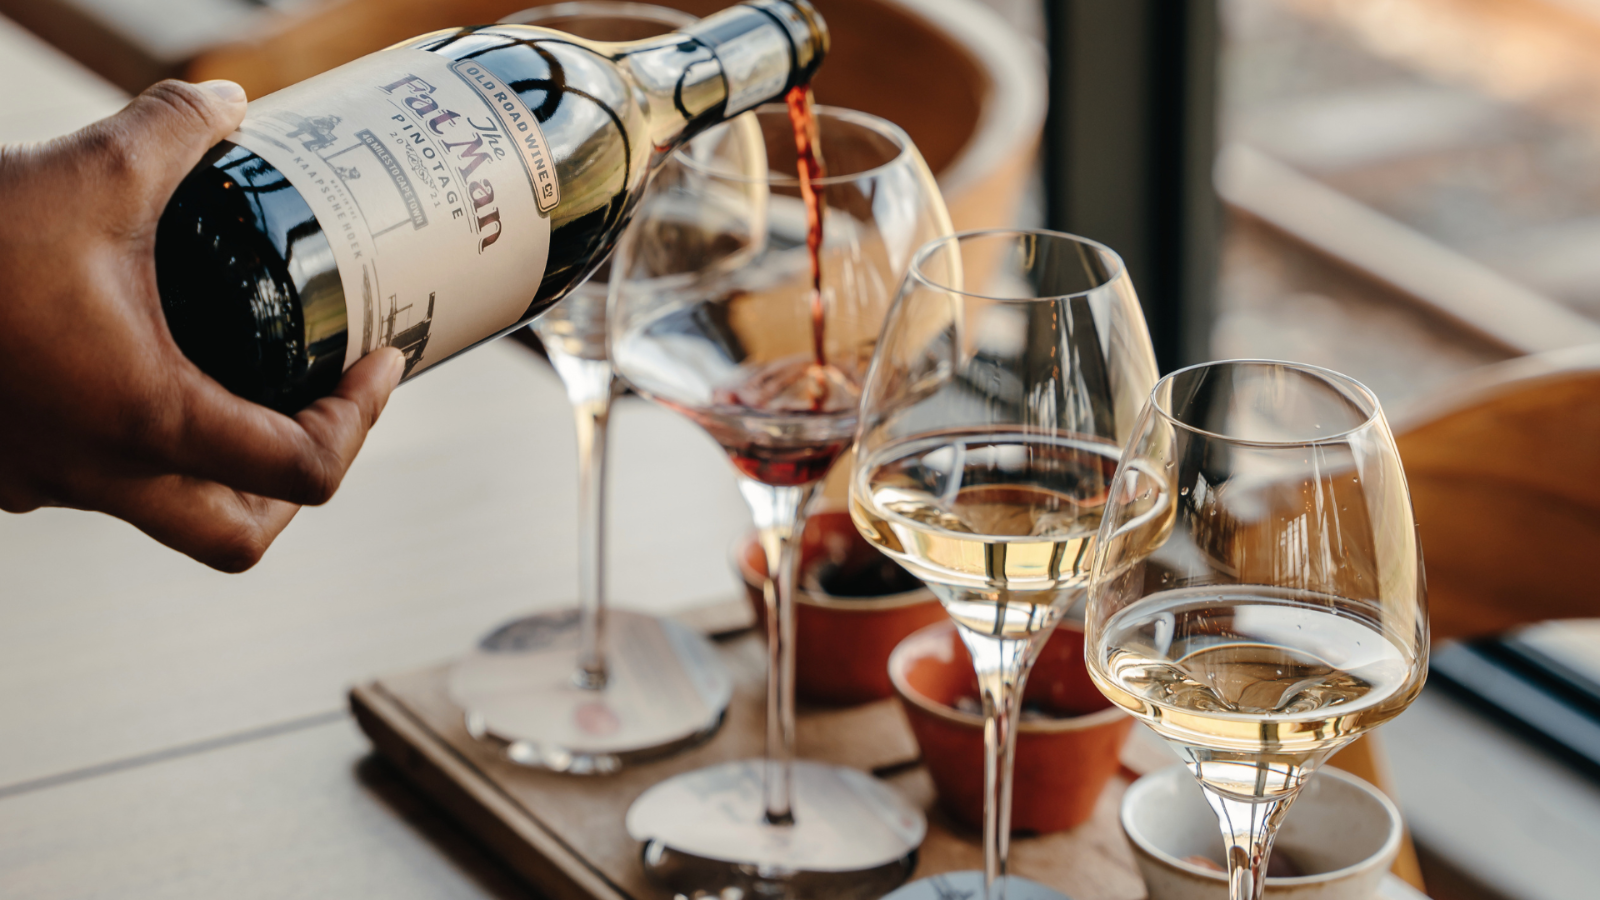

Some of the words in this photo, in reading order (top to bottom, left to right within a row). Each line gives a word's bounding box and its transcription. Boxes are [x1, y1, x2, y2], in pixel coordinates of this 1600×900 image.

[380, 73, 461, 134] Fat
[441, 132, 502, 254] Man
[391, 114, 464, 219] PINOTAGE
[466, 66, 496, 91] OLD
[493, 91, 529, 133] ROAD
[524, 132, 549, 183] WINE
[467, 116, 506, 161] The
[362, 134, 375, 144] 46
[371, 140, 393, 167] MILES
[387, 164, 400, 176] TO
[396, 175, 412, 199] CAPE
[408, 199, 424, 224] TOWN
